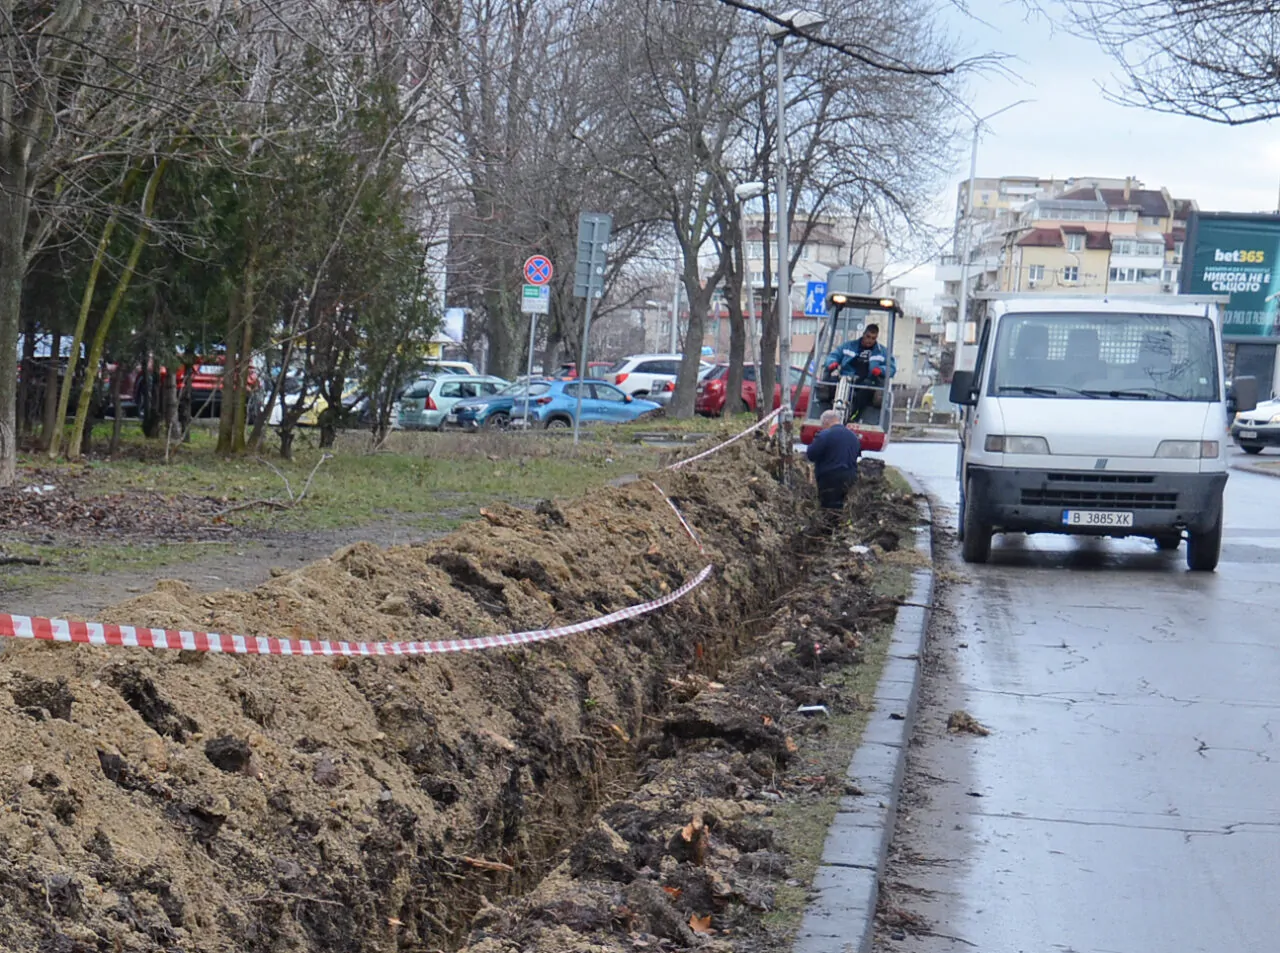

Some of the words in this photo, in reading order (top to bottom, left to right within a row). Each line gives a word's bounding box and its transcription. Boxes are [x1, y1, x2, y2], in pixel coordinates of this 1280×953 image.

[1214, 248, 1265, 263] bet365
[1203, 271, 1247, 282] НИКОГА
[1248, 273, 1262, 283] НЕ
[1263, 274, 1271, 284] Е
[1211, 281, 1261, 293] СЪЩОТО
[1073, 512, 1081, 523] B
[1086, 513, 1113, 524] 3885
[1115, 513, 1130, 525] XK
